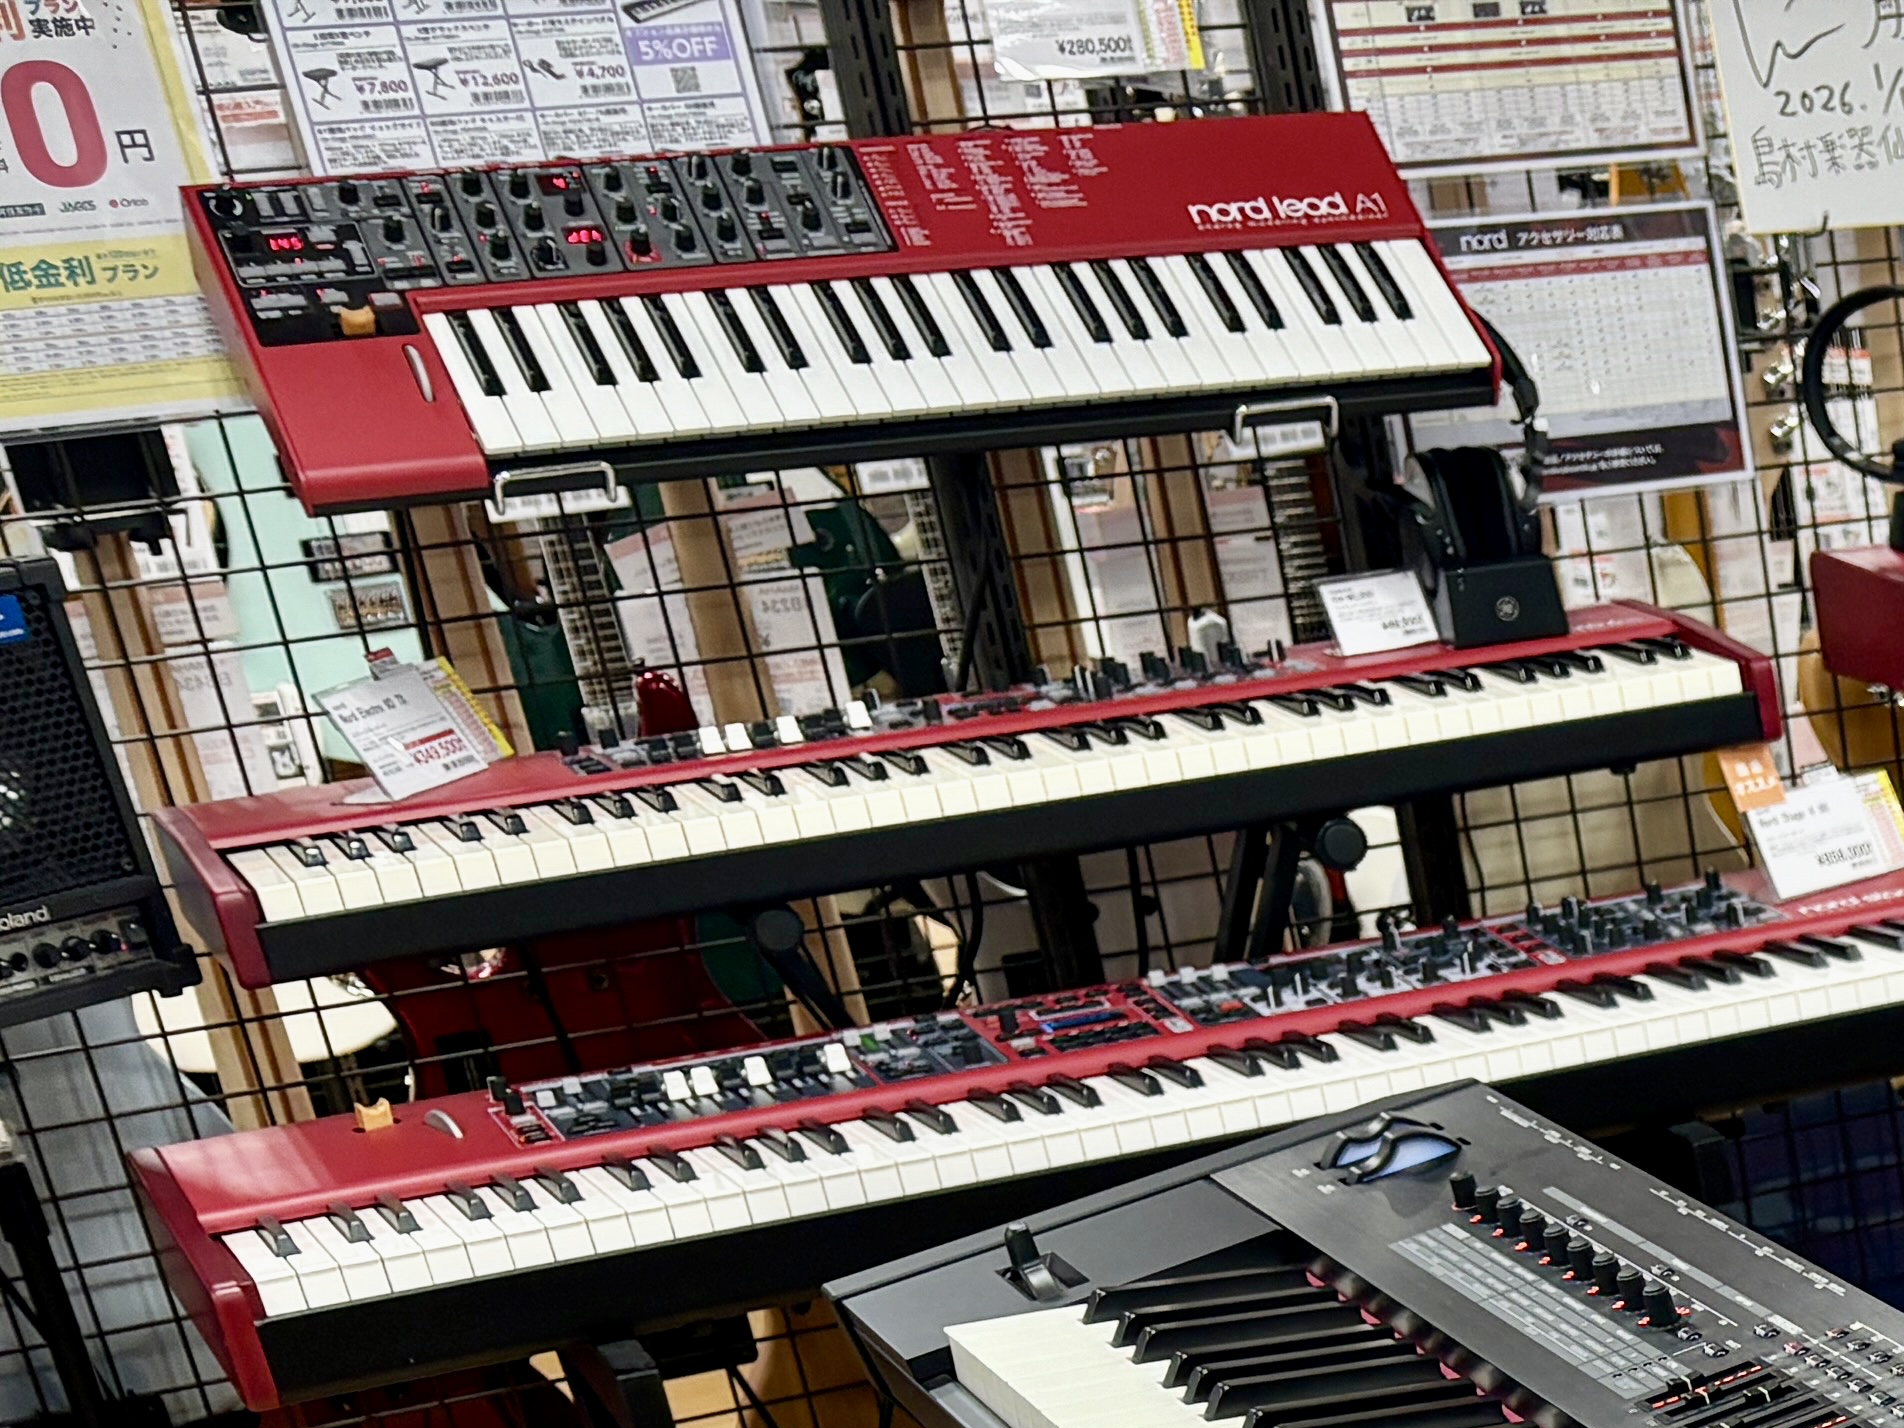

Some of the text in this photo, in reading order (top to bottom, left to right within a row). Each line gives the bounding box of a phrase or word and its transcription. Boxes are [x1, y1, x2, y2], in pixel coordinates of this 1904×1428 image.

[30, 16, 95, 38] 実施中
[639, 35, 719, 60] 5%OFF
[1, 60, 107, 187] 0
[115, 129, 155, 164] 円
[1187, 191, 1388, 224] nord lead A1
[1460, 229, 1508, 251] nord
[2, 256, 159, 292] 低金利 プラン
